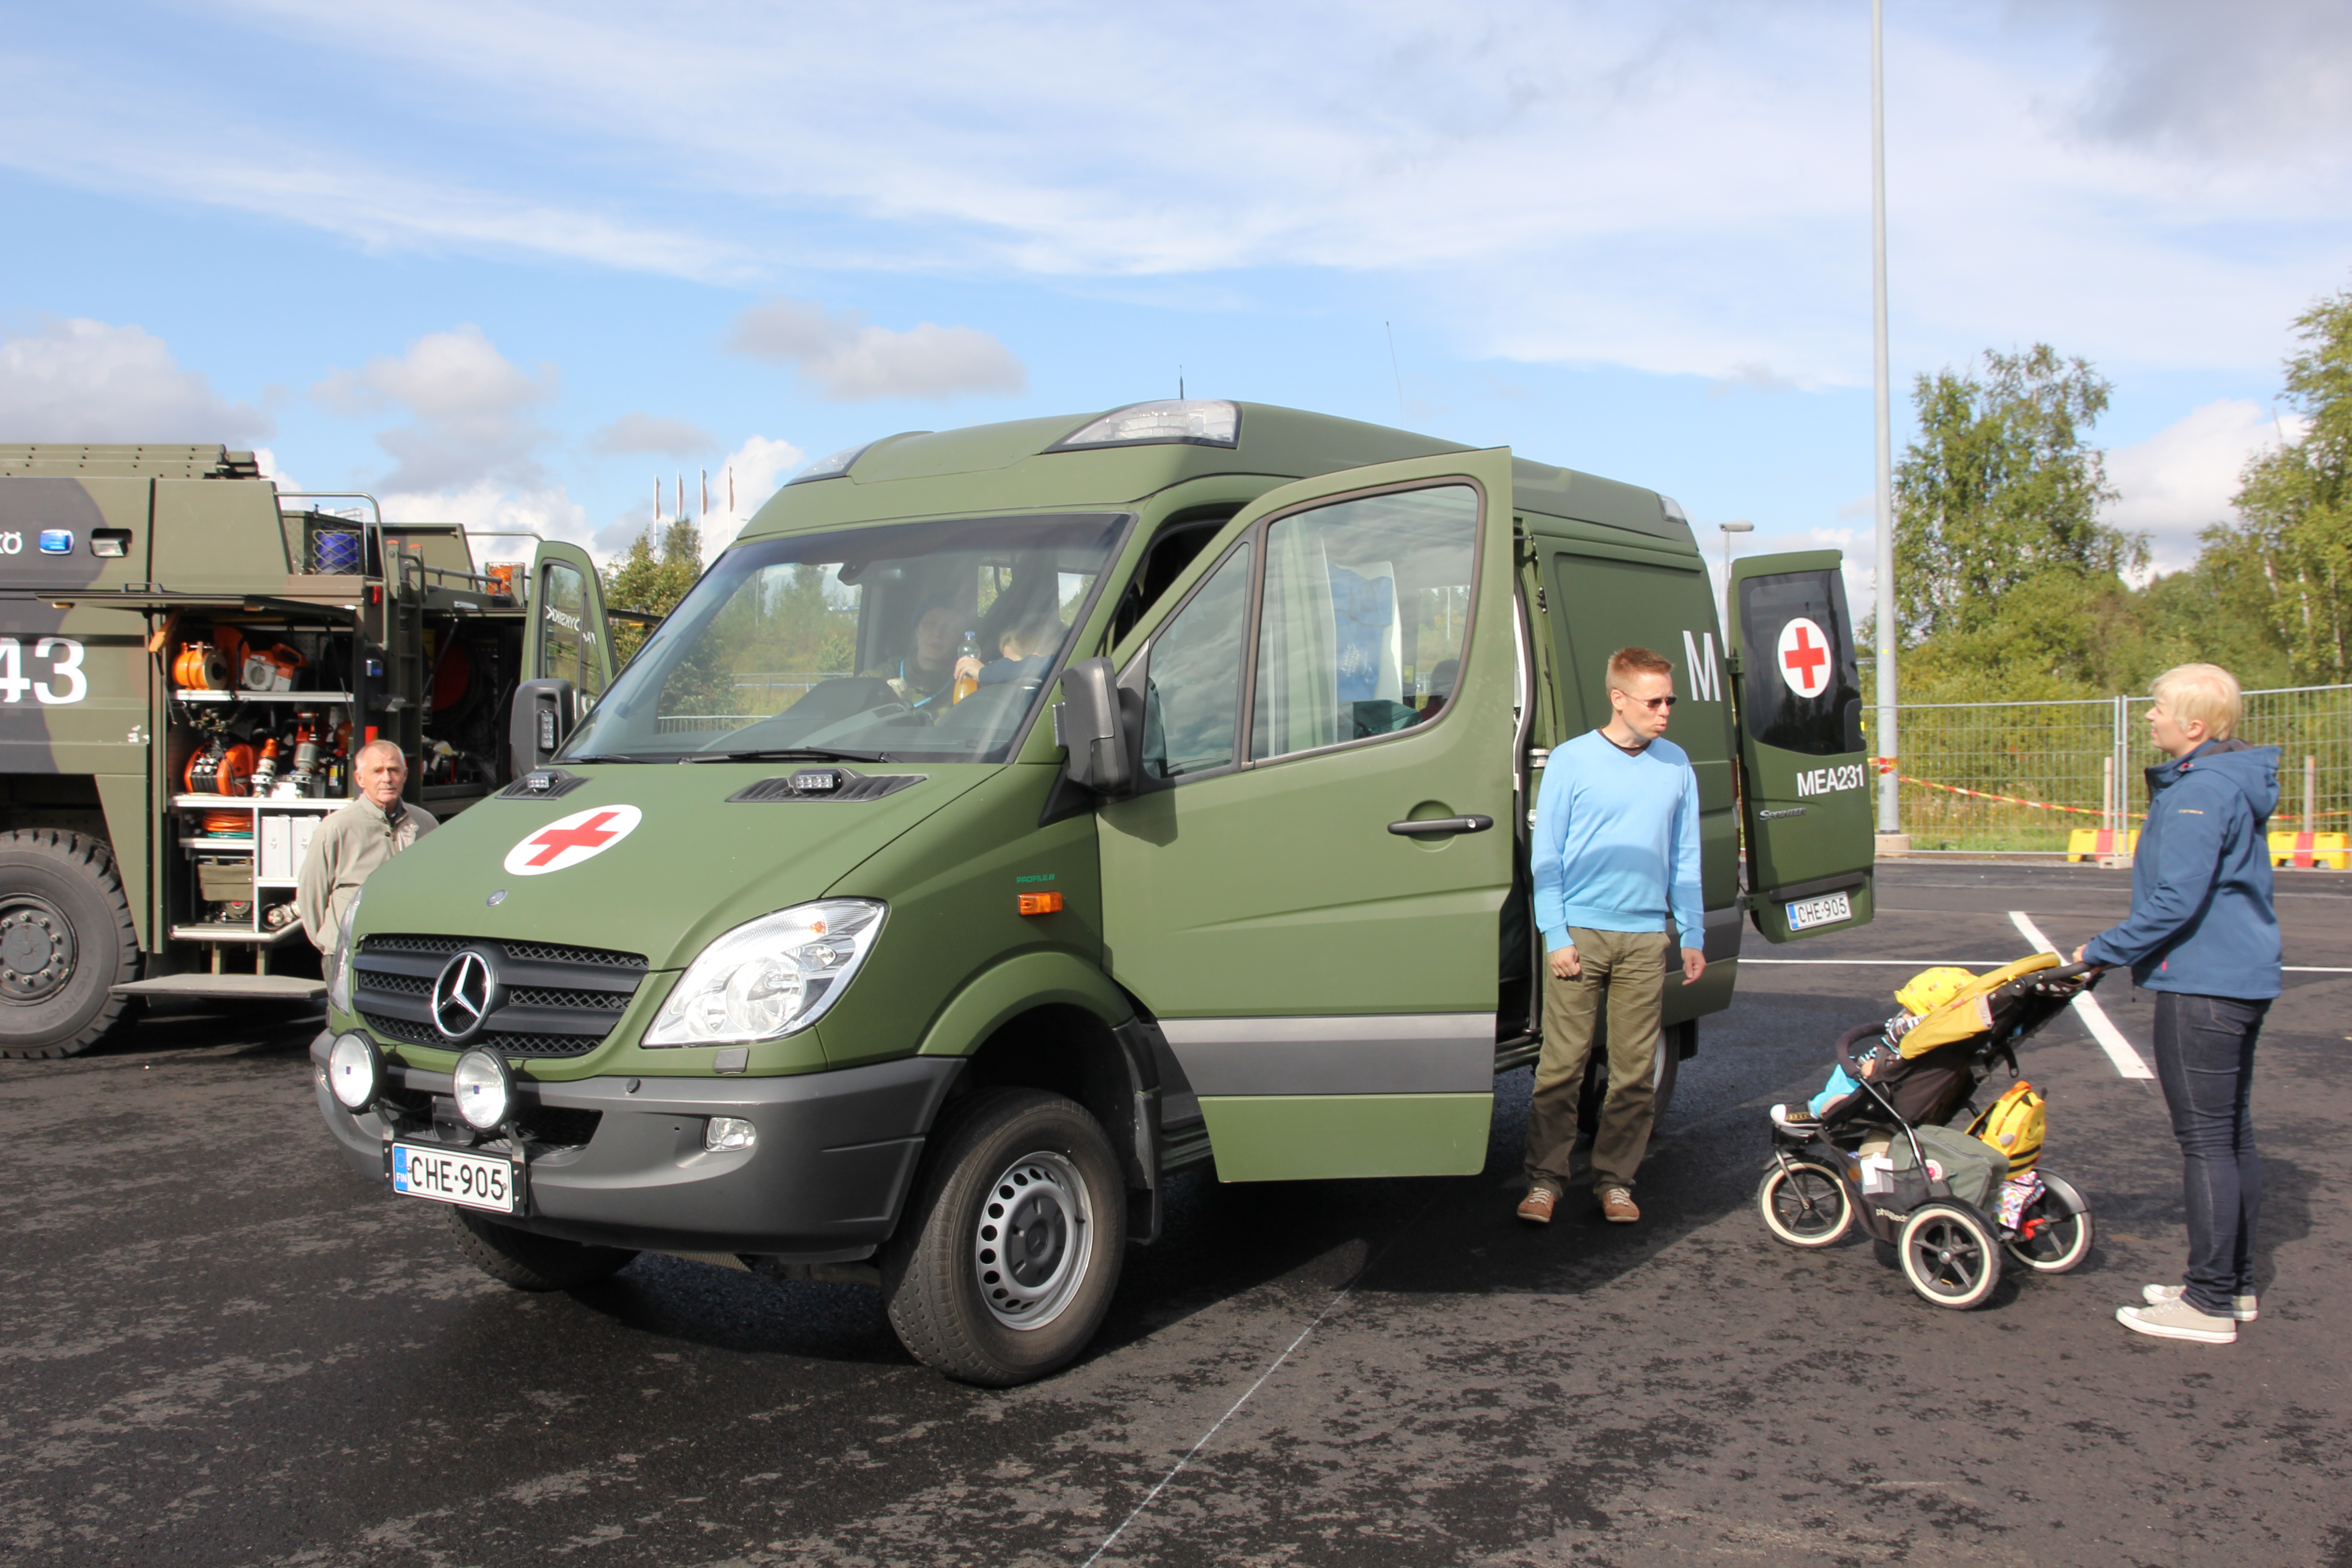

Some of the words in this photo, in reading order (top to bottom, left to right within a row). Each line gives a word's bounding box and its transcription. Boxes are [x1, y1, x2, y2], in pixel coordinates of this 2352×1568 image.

[1682, 630, 1721, 701] M
[1796, 764, 1865, 797] MEA231
[1017, 874, 1048, 883] PROFILE
[1798, 897, 1847, 923] CHE-905
[396, 1172, 407, 1183] FIN
[412, 1156, 505, 1200] CHE-905
